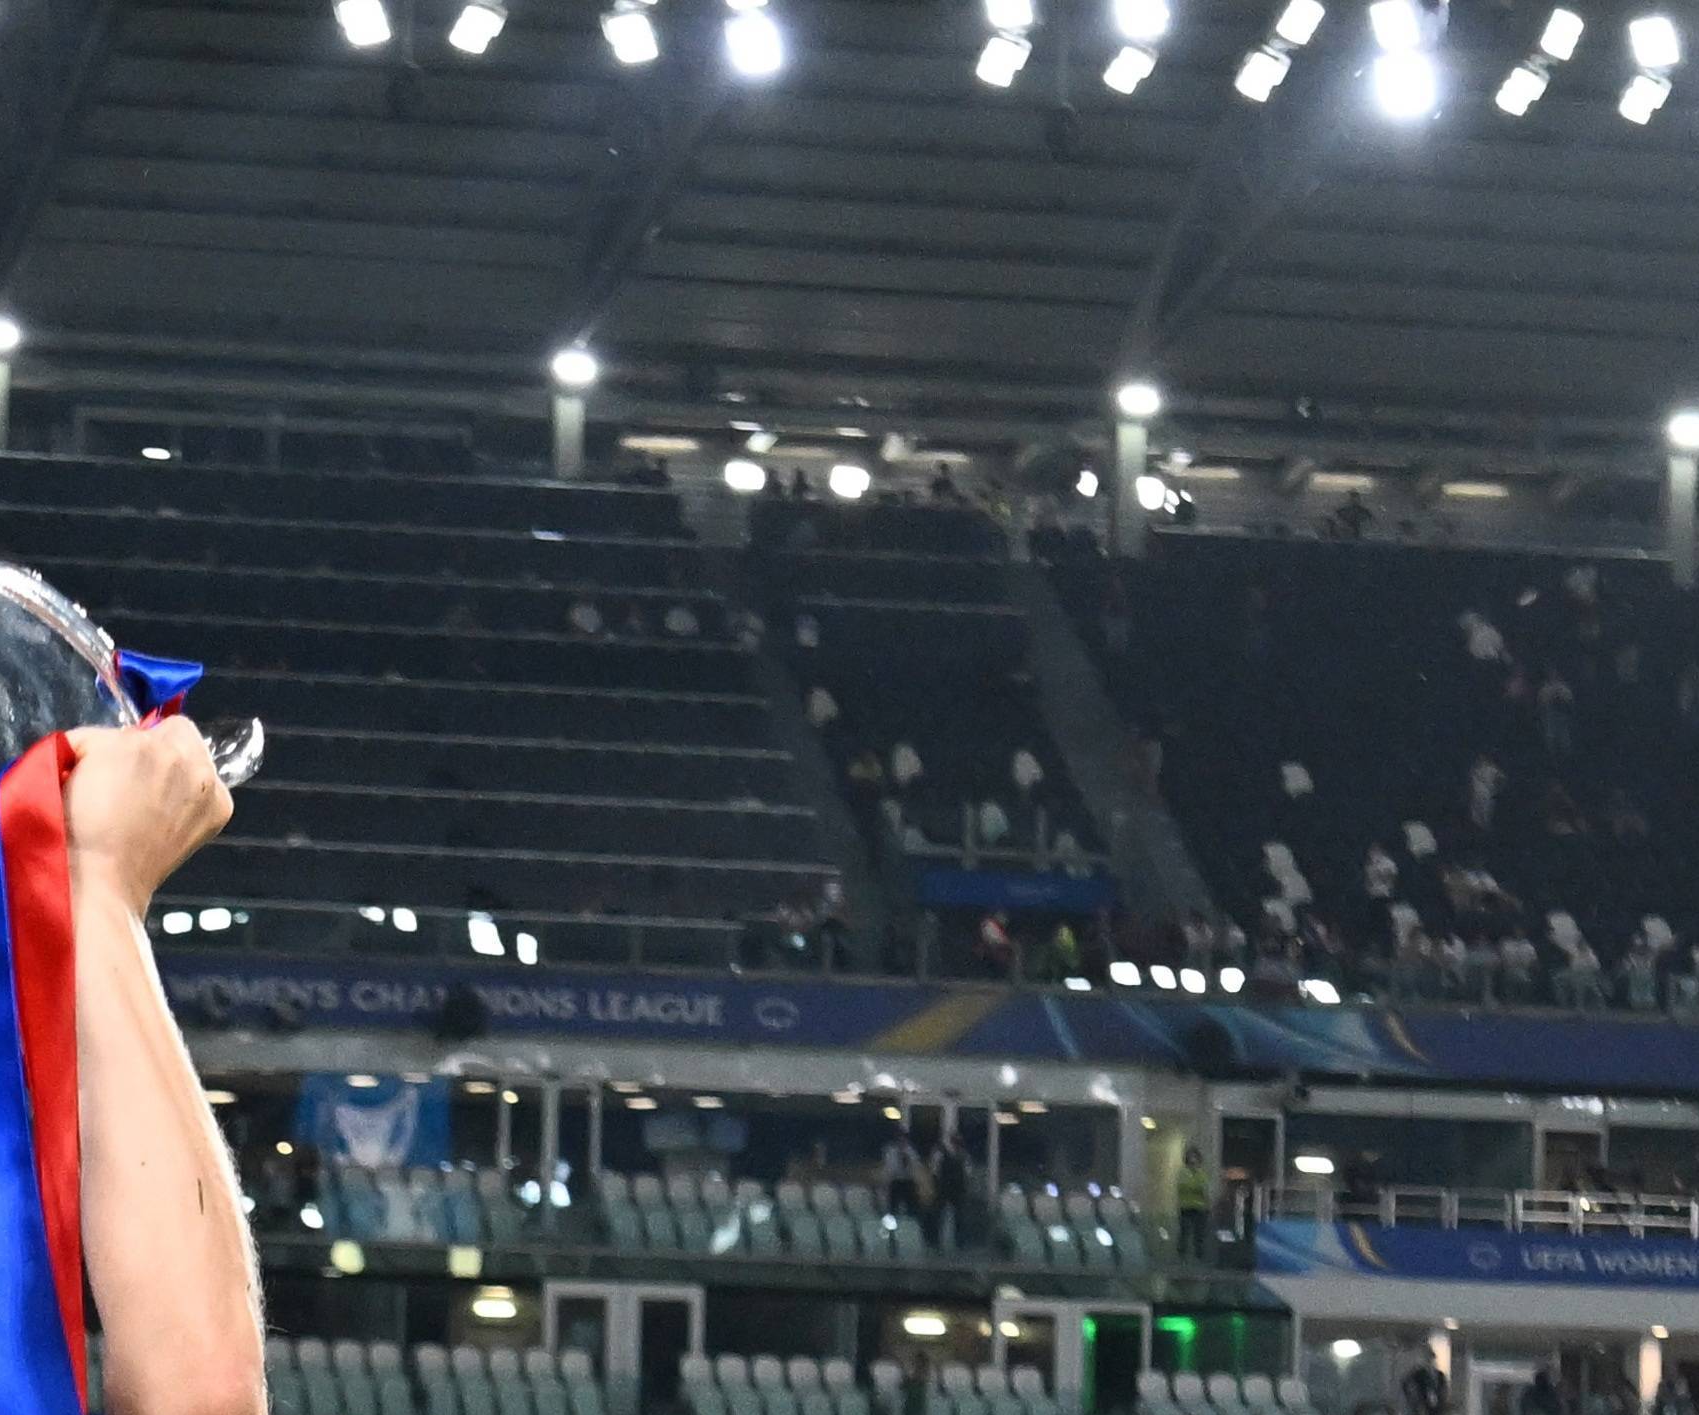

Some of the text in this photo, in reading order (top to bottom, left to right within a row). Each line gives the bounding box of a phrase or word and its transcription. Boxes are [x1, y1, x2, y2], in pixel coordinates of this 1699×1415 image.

[351, 978, 578, 1020] CHAIONS
[590, 988, 726, 1028] LEAGUE
[1520, 1246, 1587, 1275] UEFA
